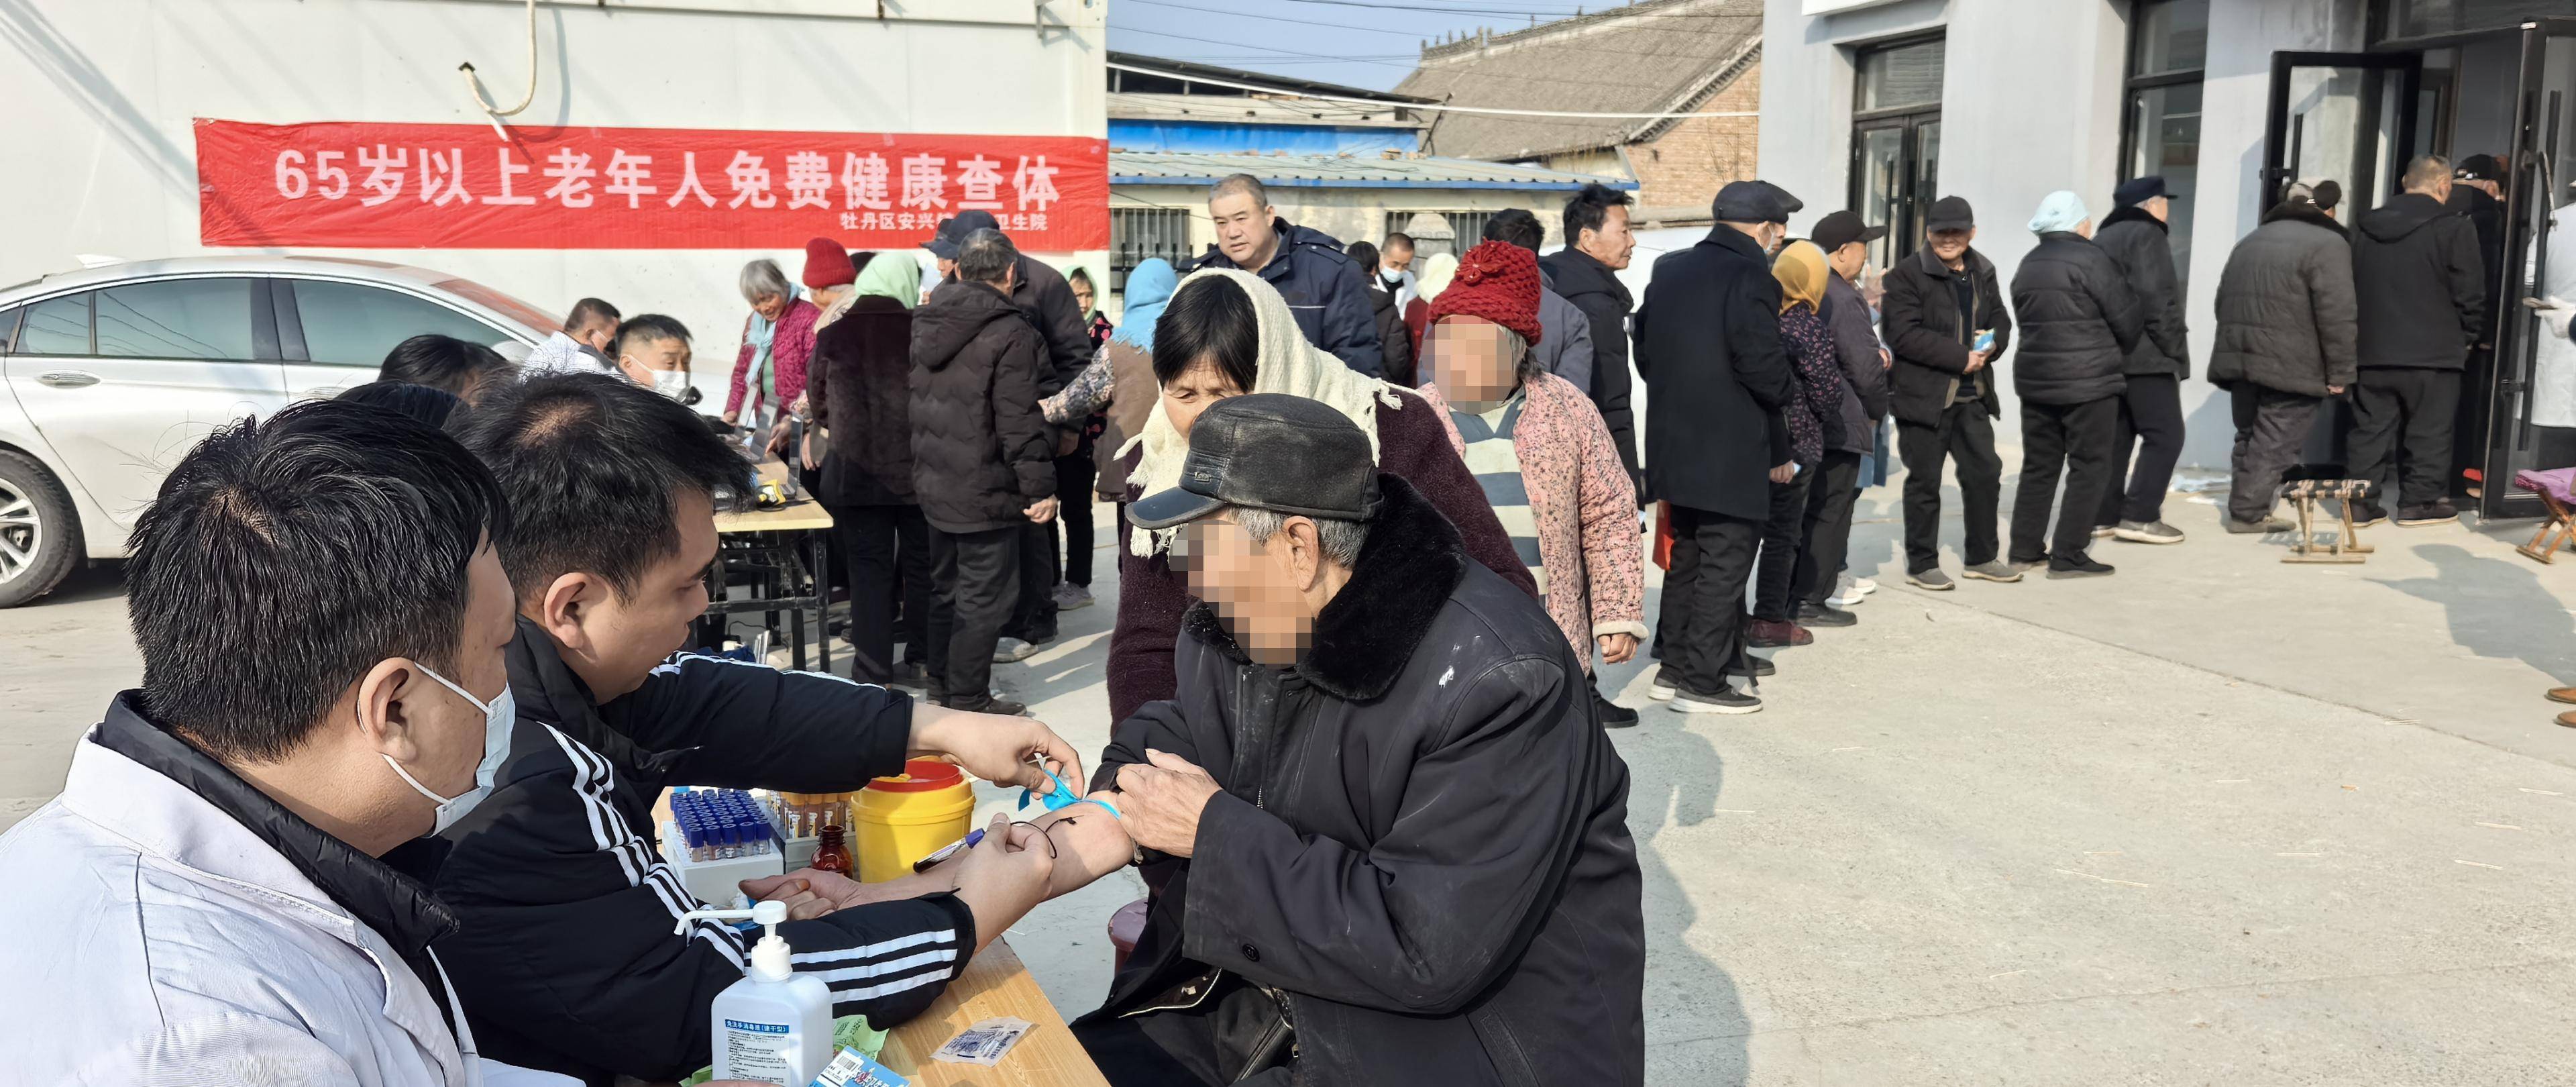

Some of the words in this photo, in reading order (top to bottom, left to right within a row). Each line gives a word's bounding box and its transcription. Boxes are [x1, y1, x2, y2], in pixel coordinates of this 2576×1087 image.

[275, 144, 1060, 211] 65岁以上老年人免费健康查体
[840, 211, 1048, 231] 牡丹区安兴卫生院
